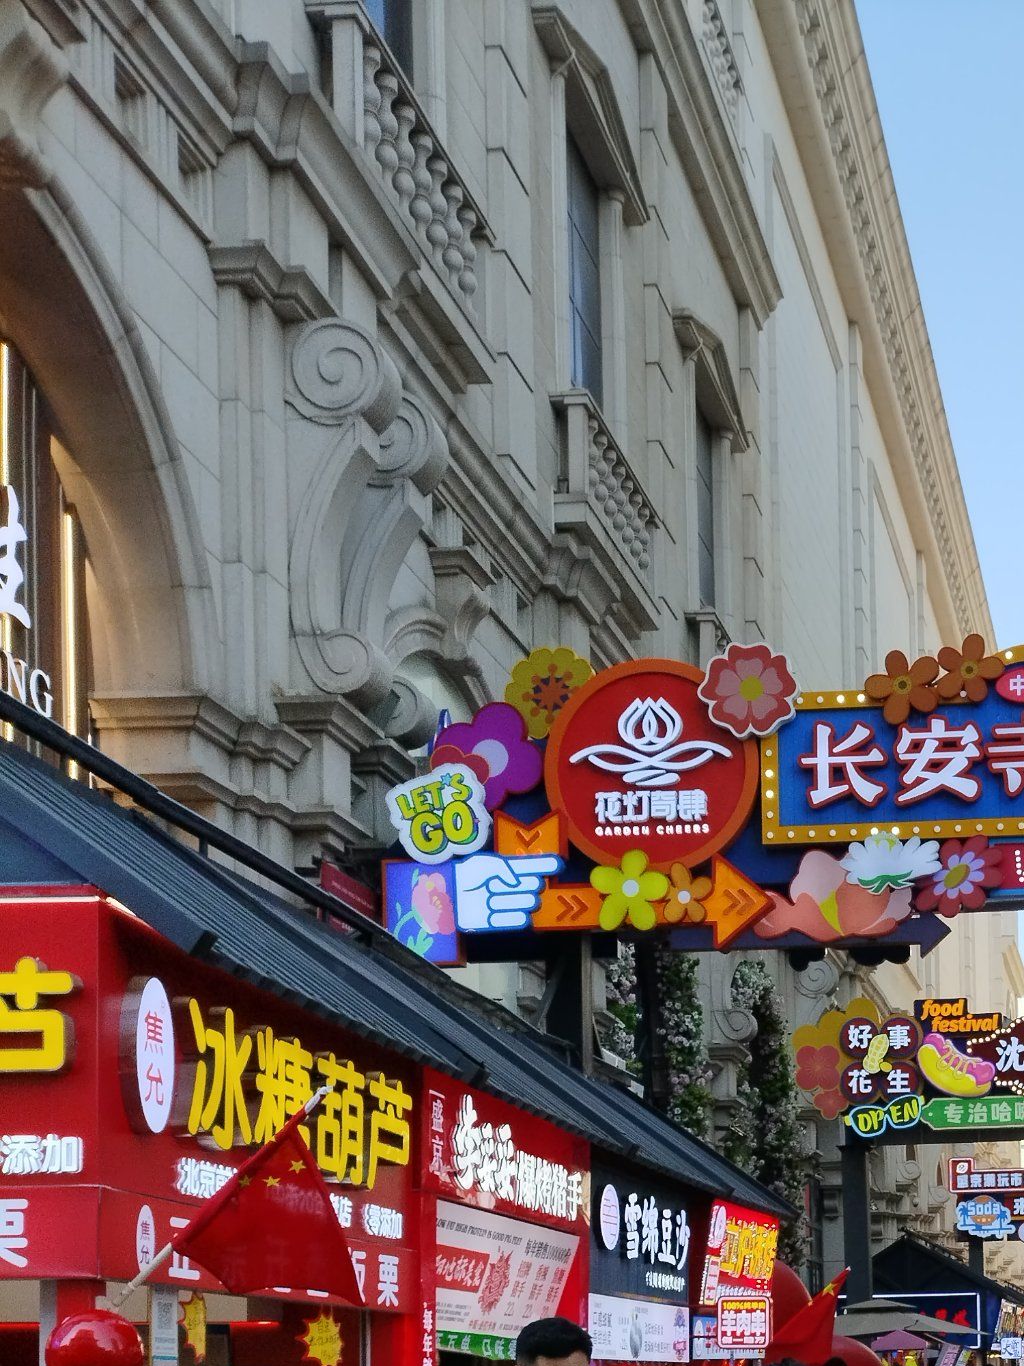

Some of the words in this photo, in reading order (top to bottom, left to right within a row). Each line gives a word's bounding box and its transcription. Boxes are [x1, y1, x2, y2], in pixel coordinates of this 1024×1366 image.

[410, 799, 480, 856] GO
[595, 825, 650, 837] GARDEN
[656, 823, 711, 836] CHEERS
[921, 999, 965, 1021] food
[930, 1013, 999, 1033] festival
[848, 1025, 911, 1049] 好事
[189, 997, 413, 1190] 冰糖葫芦
[848, 1070, 912, 1094] 花生
[0, 1134, 84, 1174] 添加
[967, 1201, 1000, 1215] Soda
[624, 1192, 691, 1271] 雪绵豆沙
[721, 1310, 766, 1337] 羊肉串
